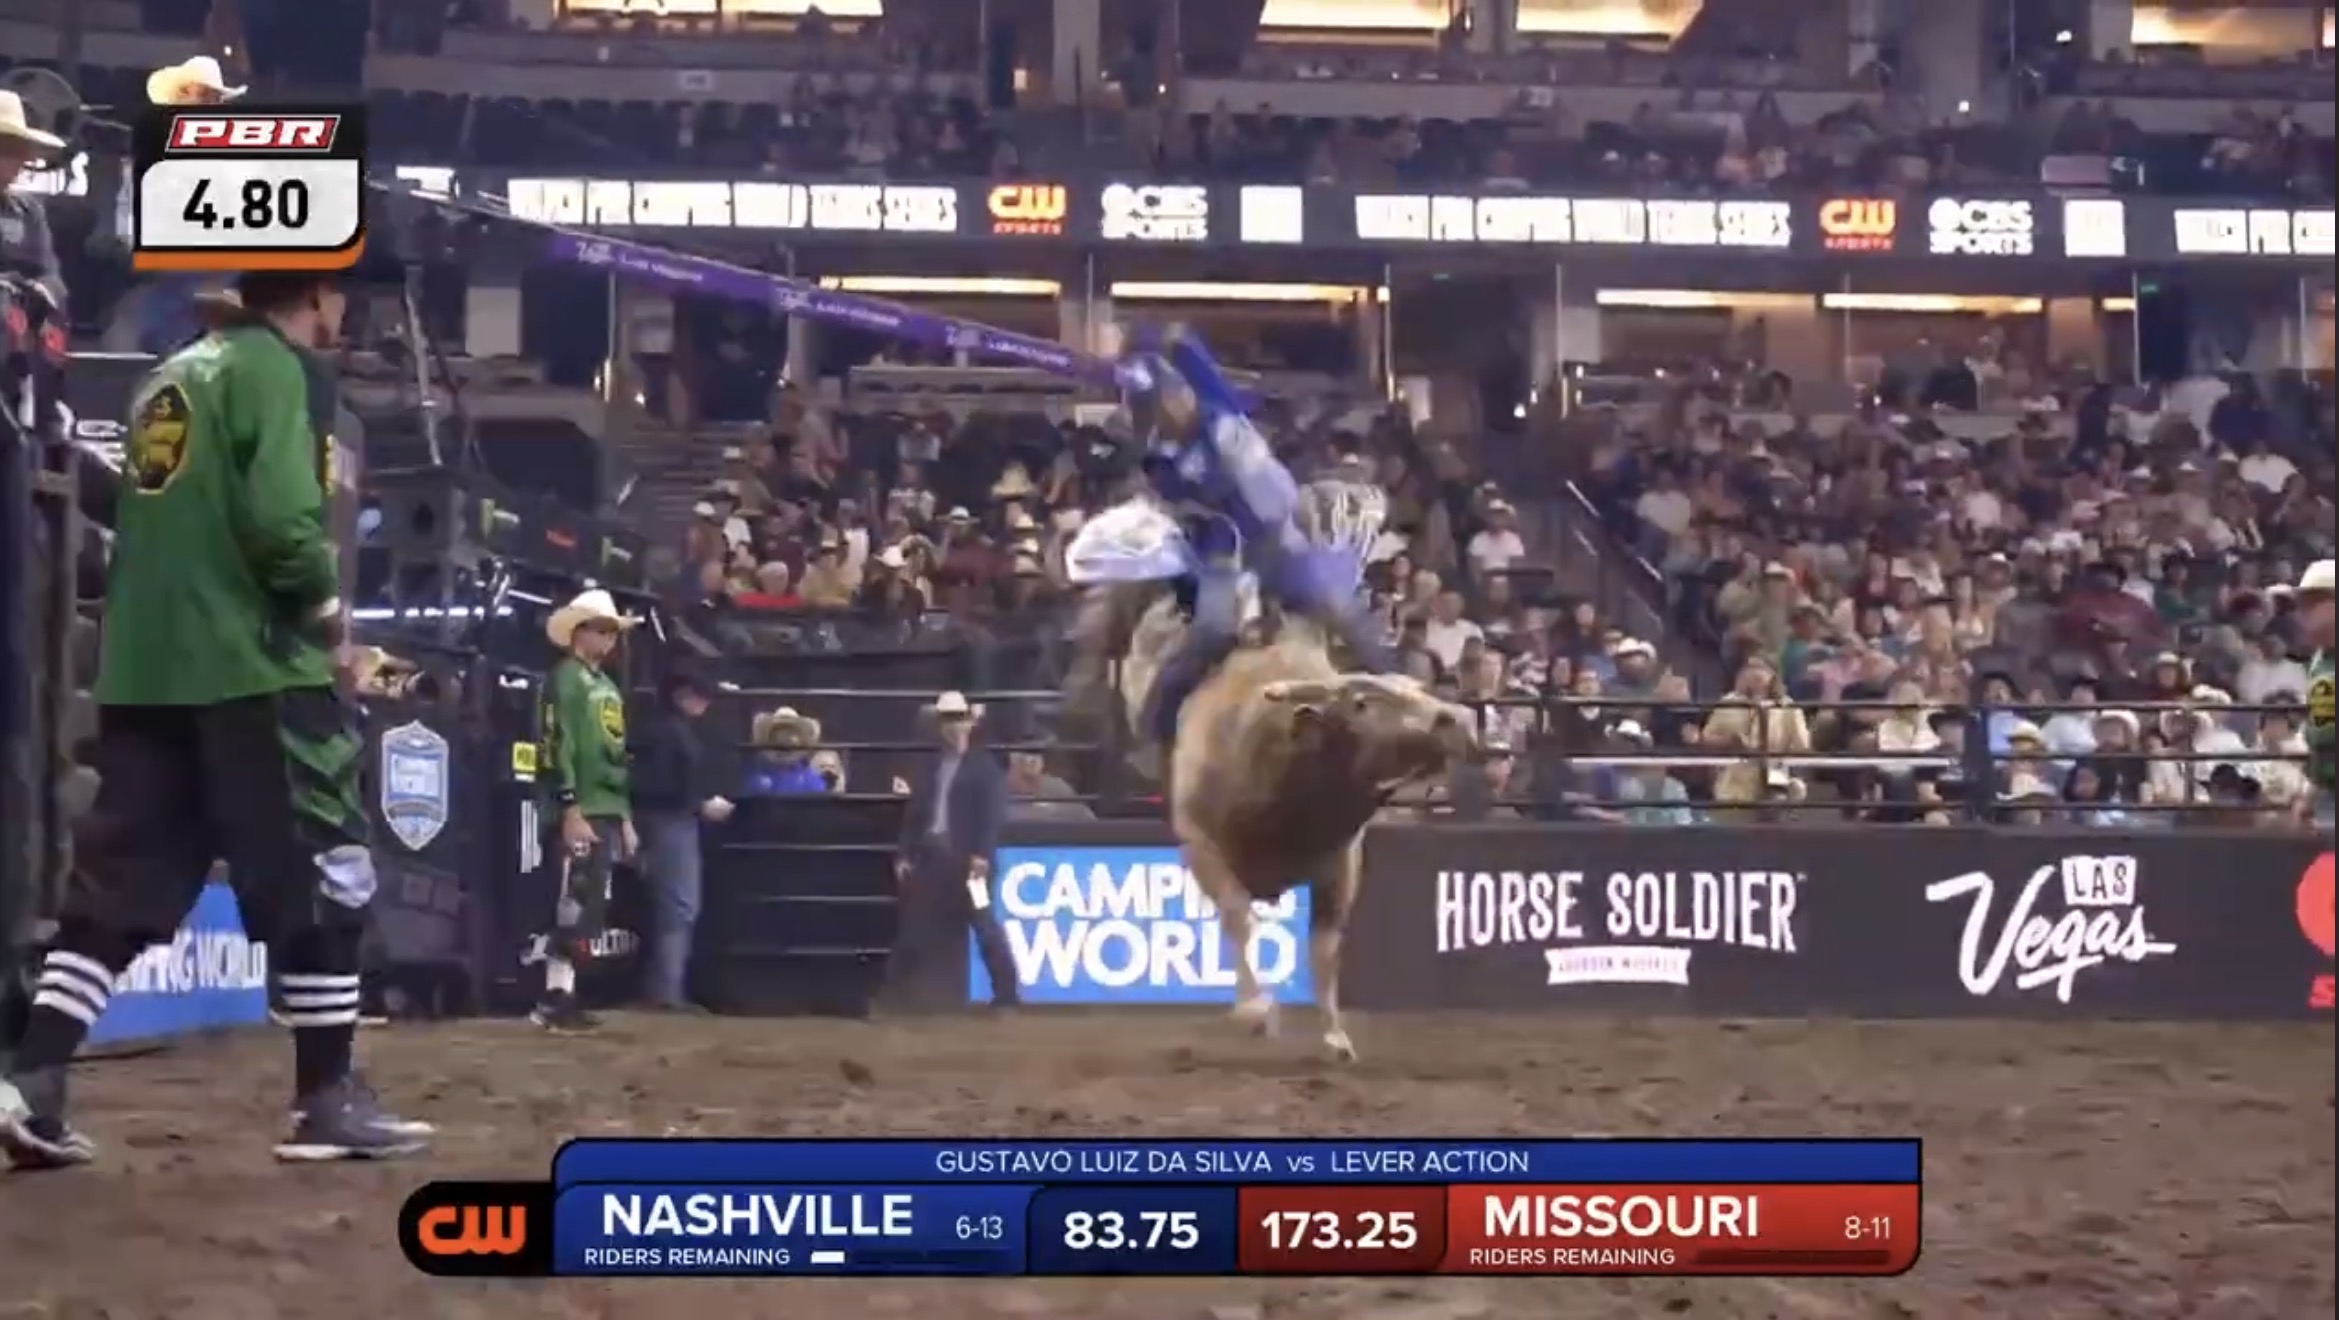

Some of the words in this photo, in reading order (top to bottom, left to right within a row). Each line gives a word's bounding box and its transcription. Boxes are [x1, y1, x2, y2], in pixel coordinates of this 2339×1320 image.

[1002, 862, 1296, 919] CAMPI
[1436, 871, 1584, 952] HORSE
[1606, 871, 1798, 952] SOLDIER
[2069, 860, 2129, 902] LAS
[1004, 919, 1296, 988] WORLD
[1926, 865, 2177, 1003] Vegas
